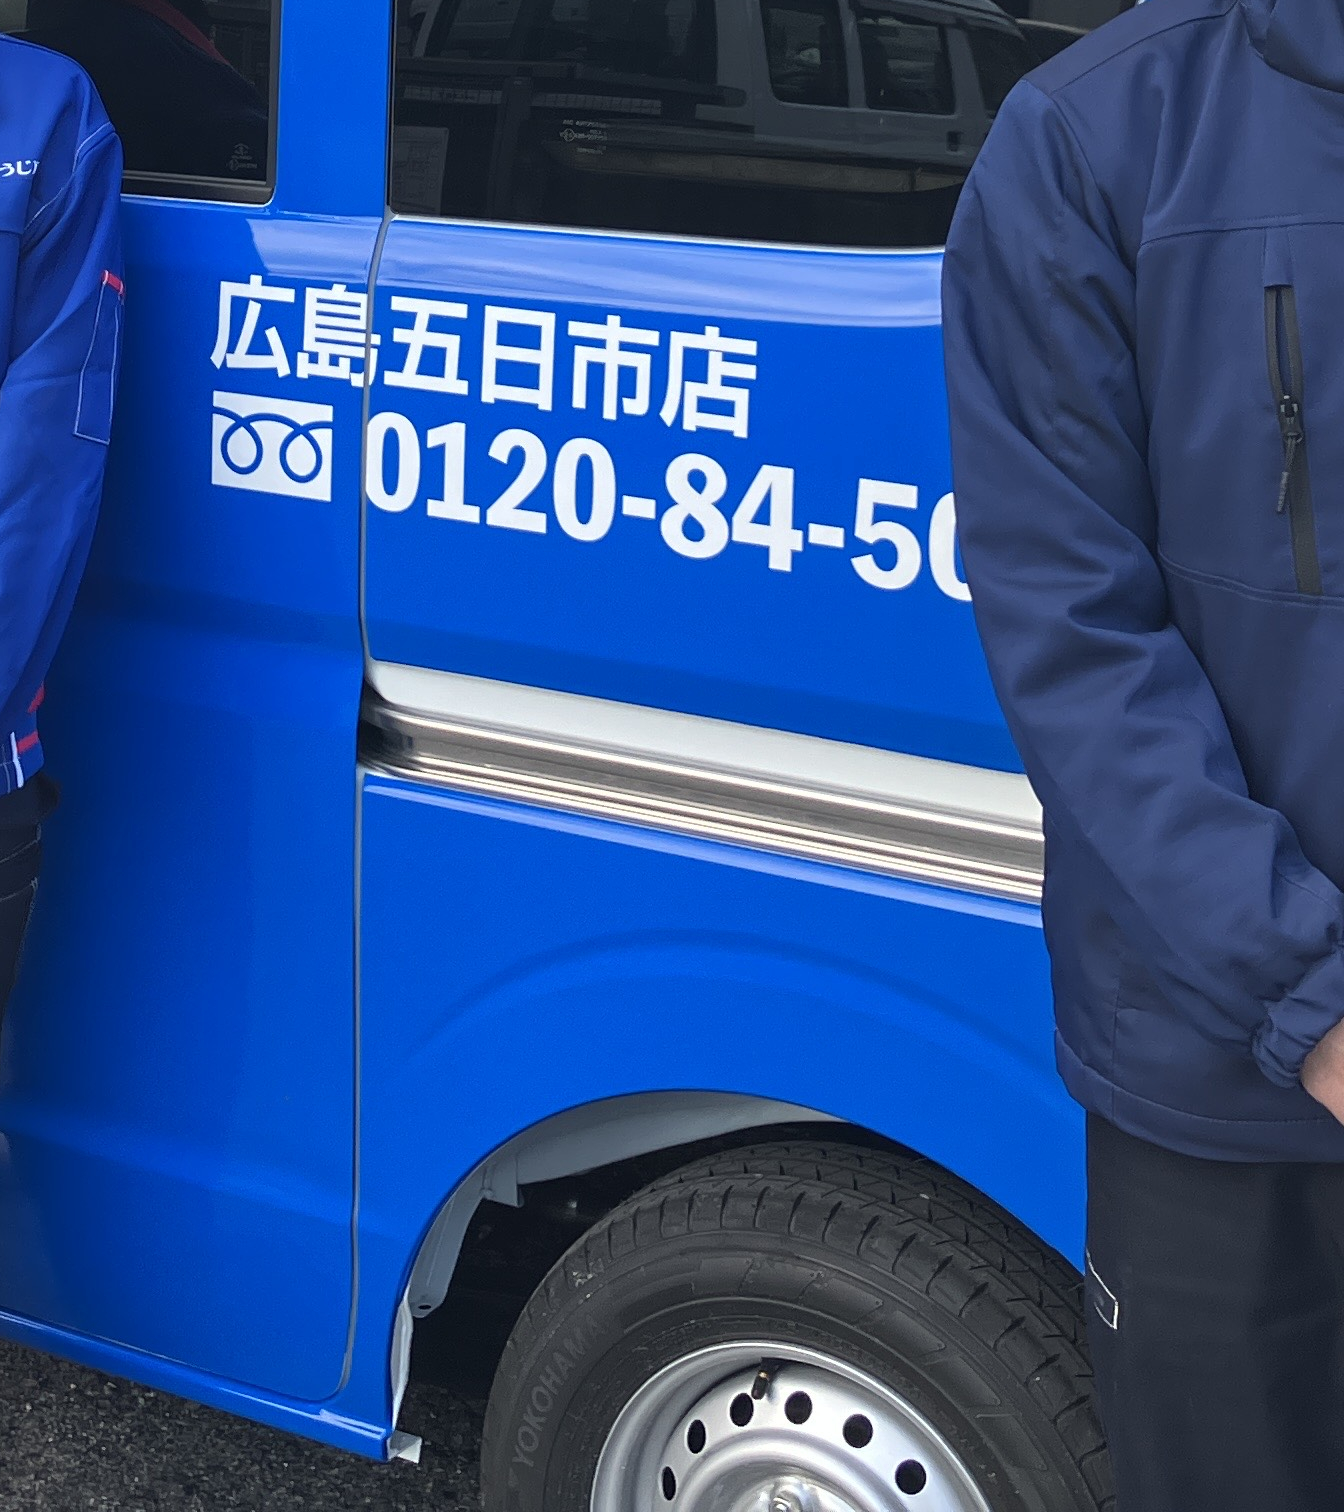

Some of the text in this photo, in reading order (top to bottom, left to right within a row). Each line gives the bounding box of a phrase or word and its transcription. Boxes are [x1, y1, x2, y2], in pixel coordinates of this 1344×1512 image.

[210, 274, 758, 438] 広島五日市店
[512, 1314, 604, 1467] YOKOHAMA
